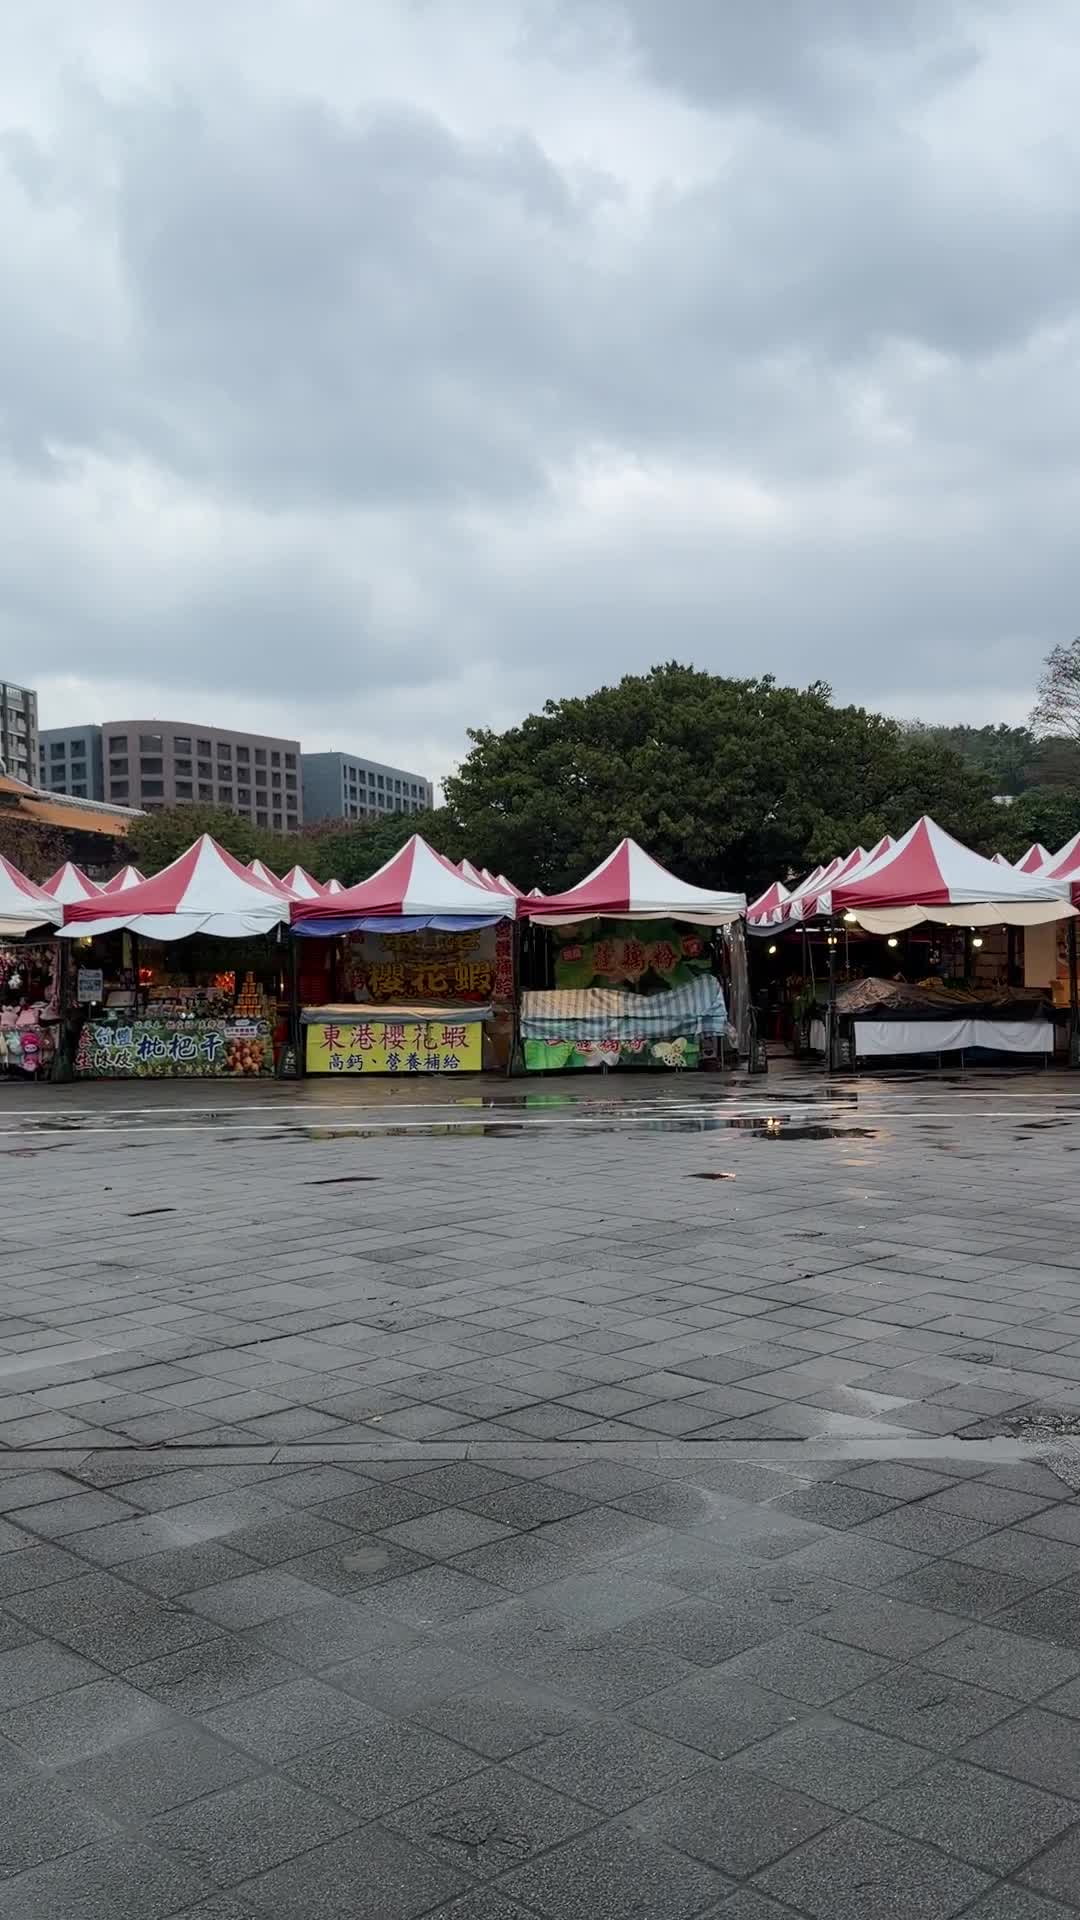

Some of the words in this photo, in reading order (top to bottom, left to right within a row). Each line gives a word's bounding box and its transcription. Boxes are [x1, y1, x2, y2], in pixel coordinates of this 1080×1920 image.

[367, 960, 491, 992] 櫻花蝦
[320, 1024, 470, 1051] 東港櫻花蝦
[329, 1052, 460, 1070] 高鈣、營養補給
